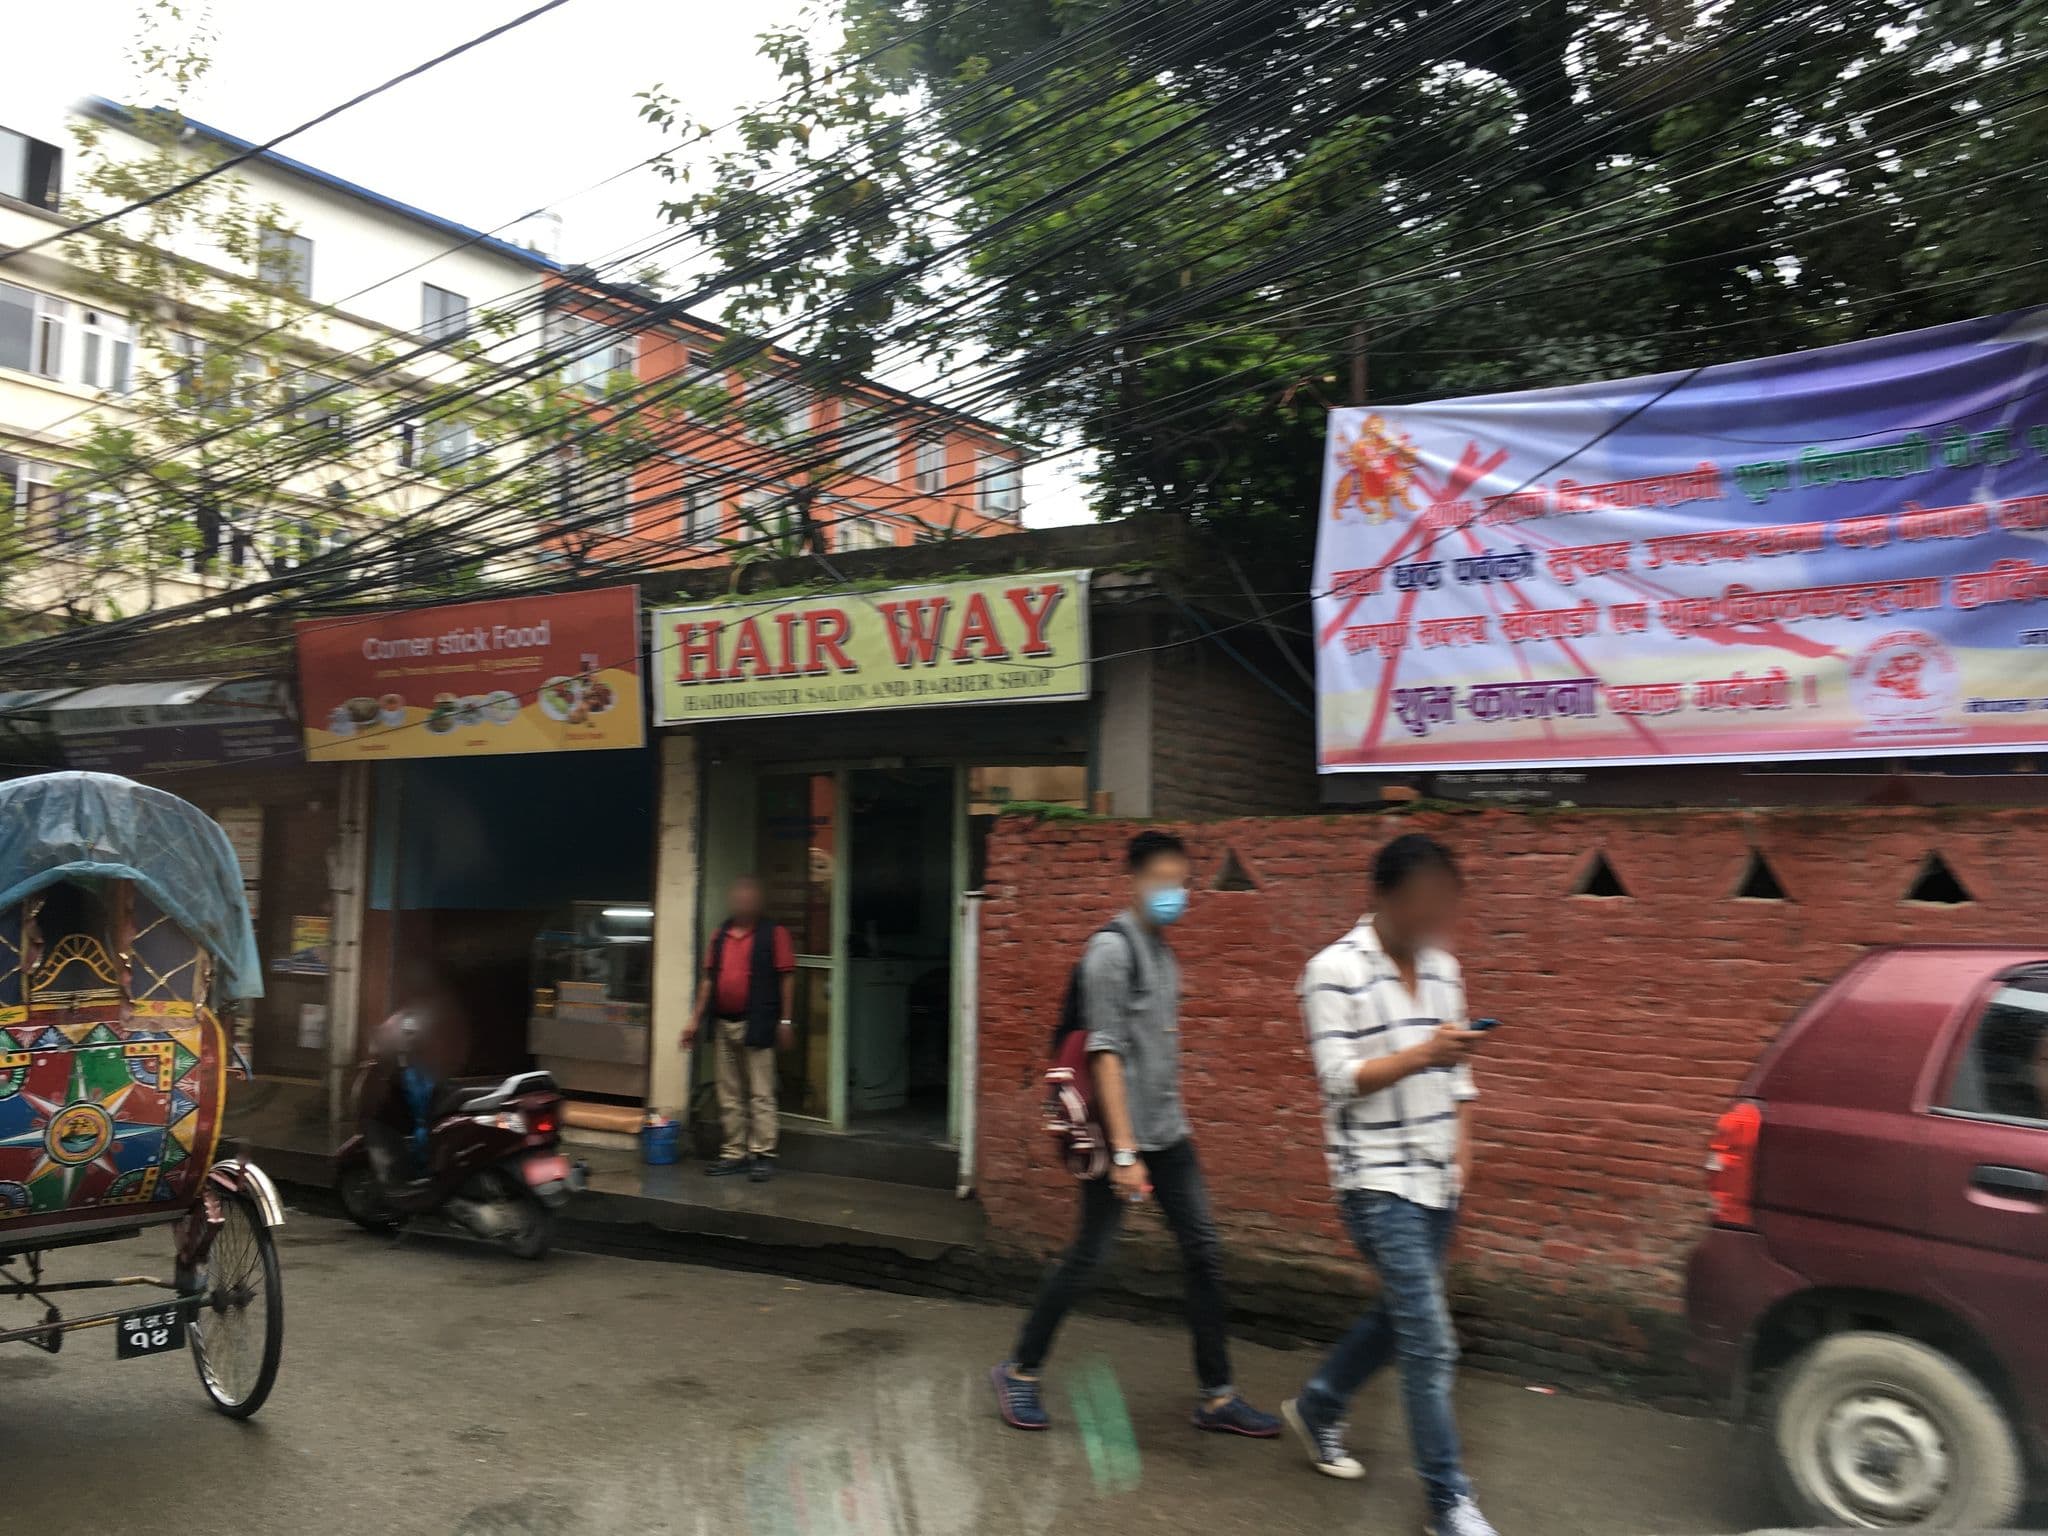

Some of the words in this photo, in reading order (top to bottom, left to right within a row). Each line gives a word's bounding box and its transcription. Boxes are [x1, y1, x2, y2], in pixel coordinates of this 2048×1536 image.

[437, 627, 490, 655] stick
[492, 619, 551, 649] Food
[675, 608, 858, 685] HAIR
[879, 584, 1066, 669] WAY
[912, 673, 994, 696] BARBER
[997, 668, 1056, 690] SHOP
